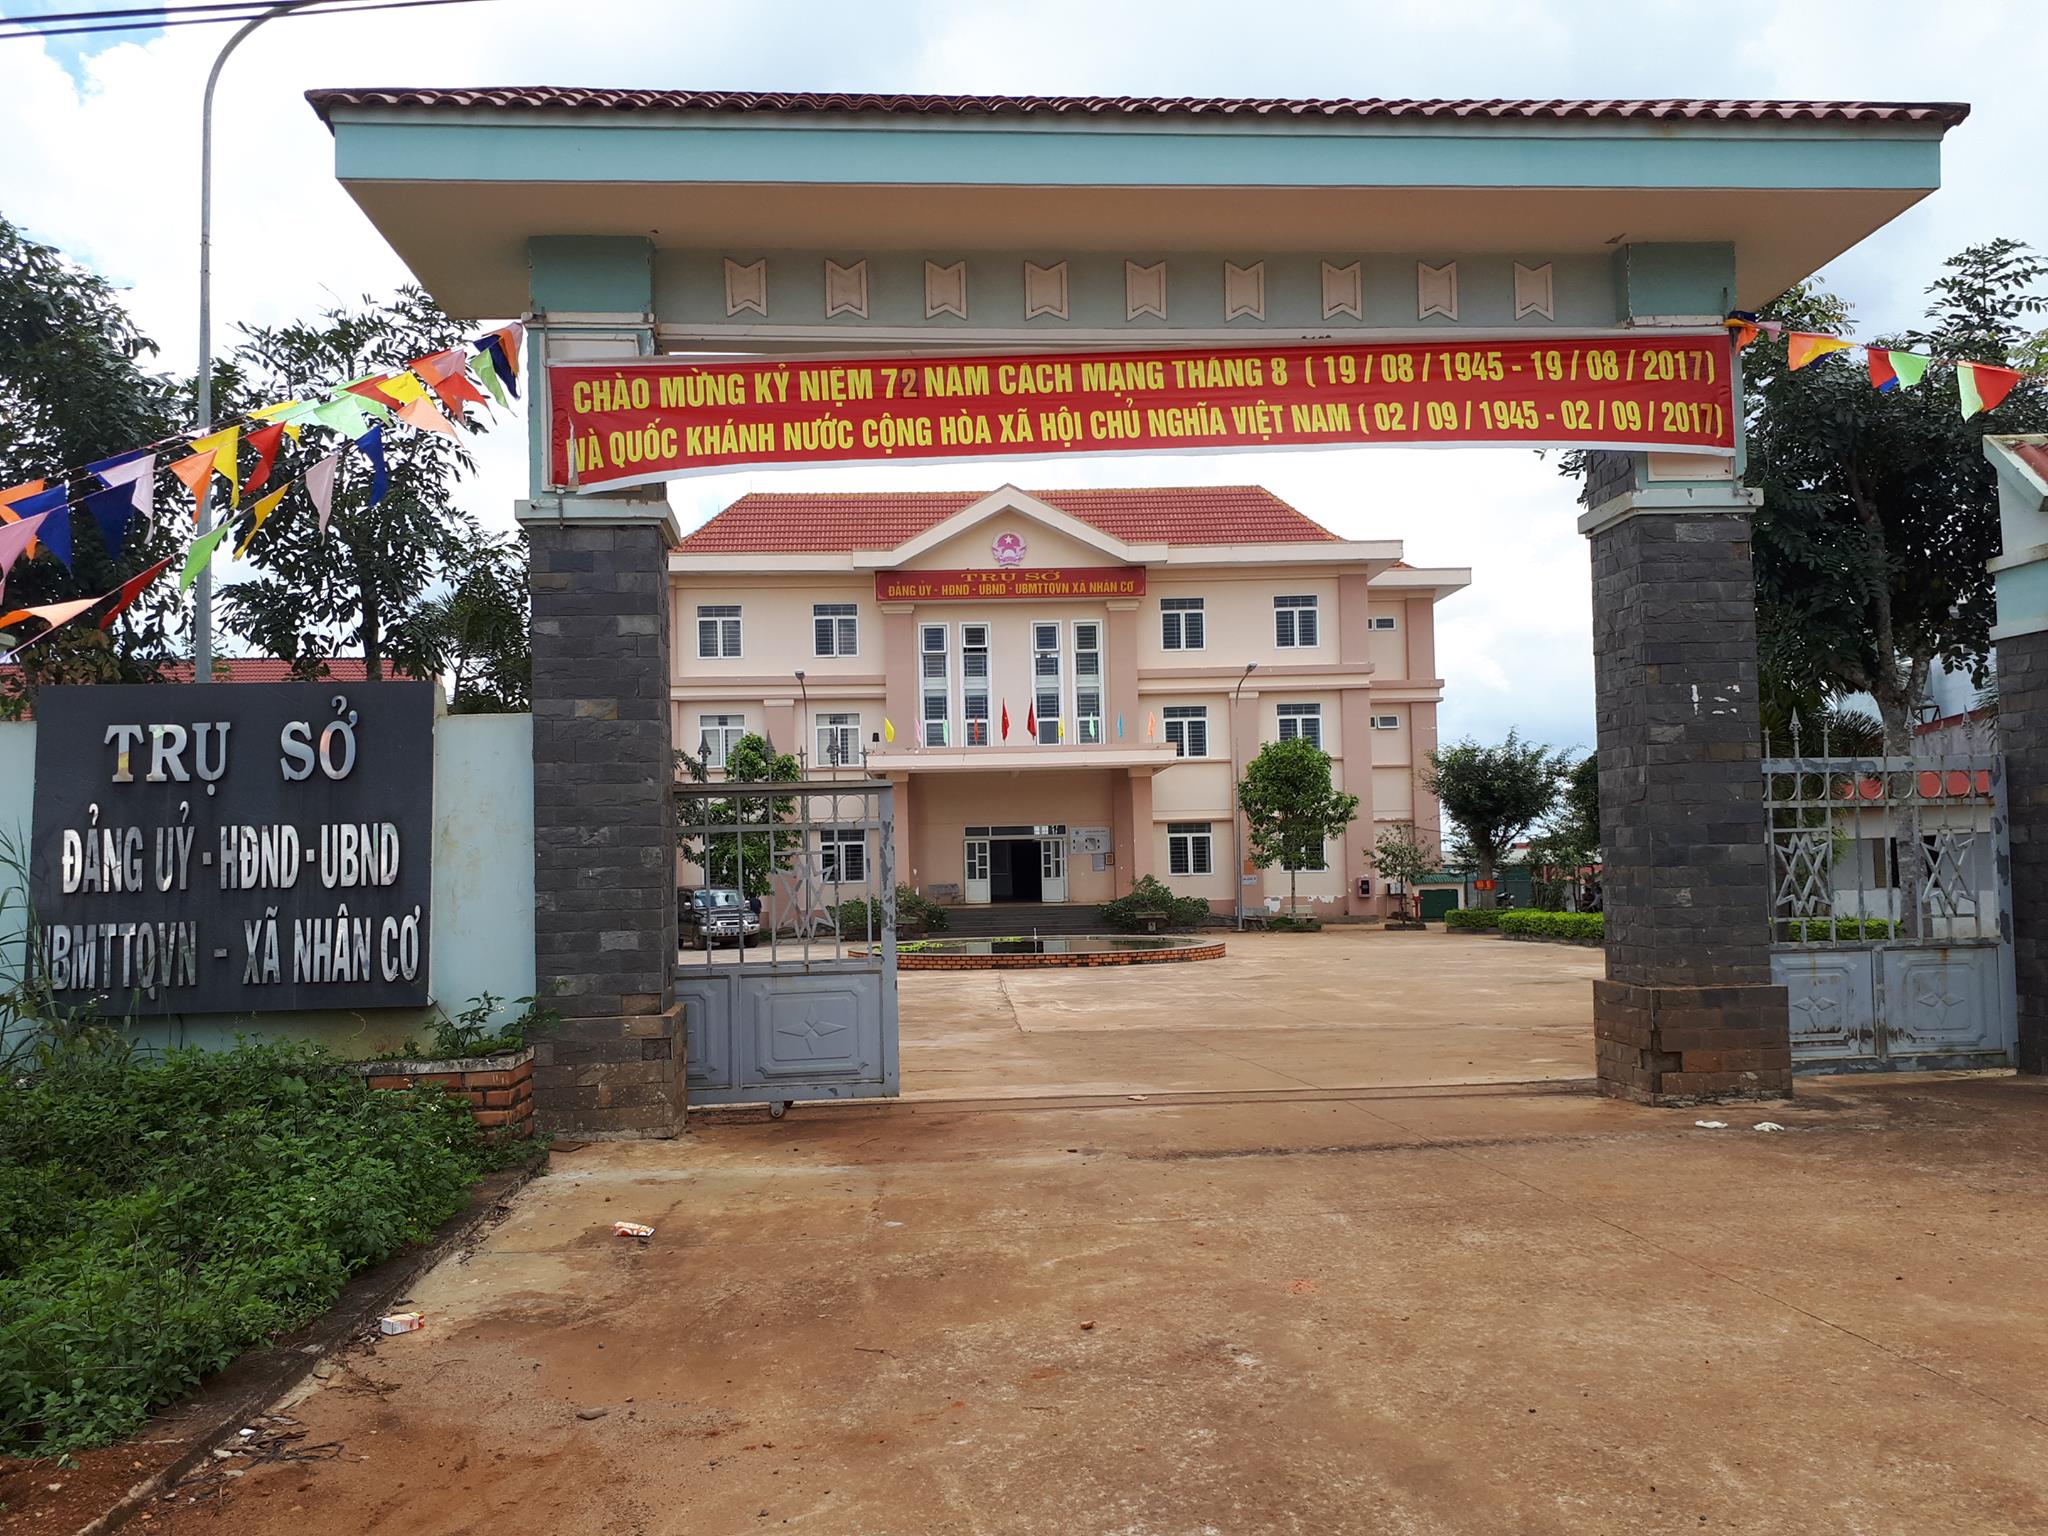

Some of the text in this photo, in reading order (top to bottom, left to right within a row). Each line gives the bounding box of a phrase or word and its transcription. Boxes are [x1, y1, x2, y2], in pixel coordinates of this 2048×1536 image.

[573, 372, 650, 414] CHÀO
[659, 368, 746, 408] MỪNG
[755, 363, 790, 404] KỶ
[800, 367, 873, 407] NIỆM
[881, 368, 918, 399] 72
[1081, 361, 1164, 397] MẠNG
[1172, 357, 1264, 389] THÁNG
[1271, 358, 1288, 385] 8
[609, 418, 678, 468] QUỐC
[686, 418, 775, 457] KHÁNH
[784, 412, 854, 451] NƯỚC
[862, 413, 932, 454] CỘNG
[940, 409, 992, 445] HÒA
[998, 408, 1034, 443] XÃ
[1040, 406, 1083, 447] HỘI
[1090, 398, 1141, 440] CHỦ
[1148, 402, 1227, 437] NGHĨA
[1231, 400, 1283, 441] VIỆT
[1291, 403, 1351, 433] NAM
[979, 584, 1005, 595] UBND
[1015, 583, 1069, 594] UBMTTQVN
[103, 694, 359, 797] TRỤ SỞ
[61, 802, 144, 894] ĐẢNG
[155, 800, 195, 891] UỶ
[243, 906, 281, 985] XÃ
[293, 903, 372, 983] NHÂN
[380, 904, 421, 982] CƠ
